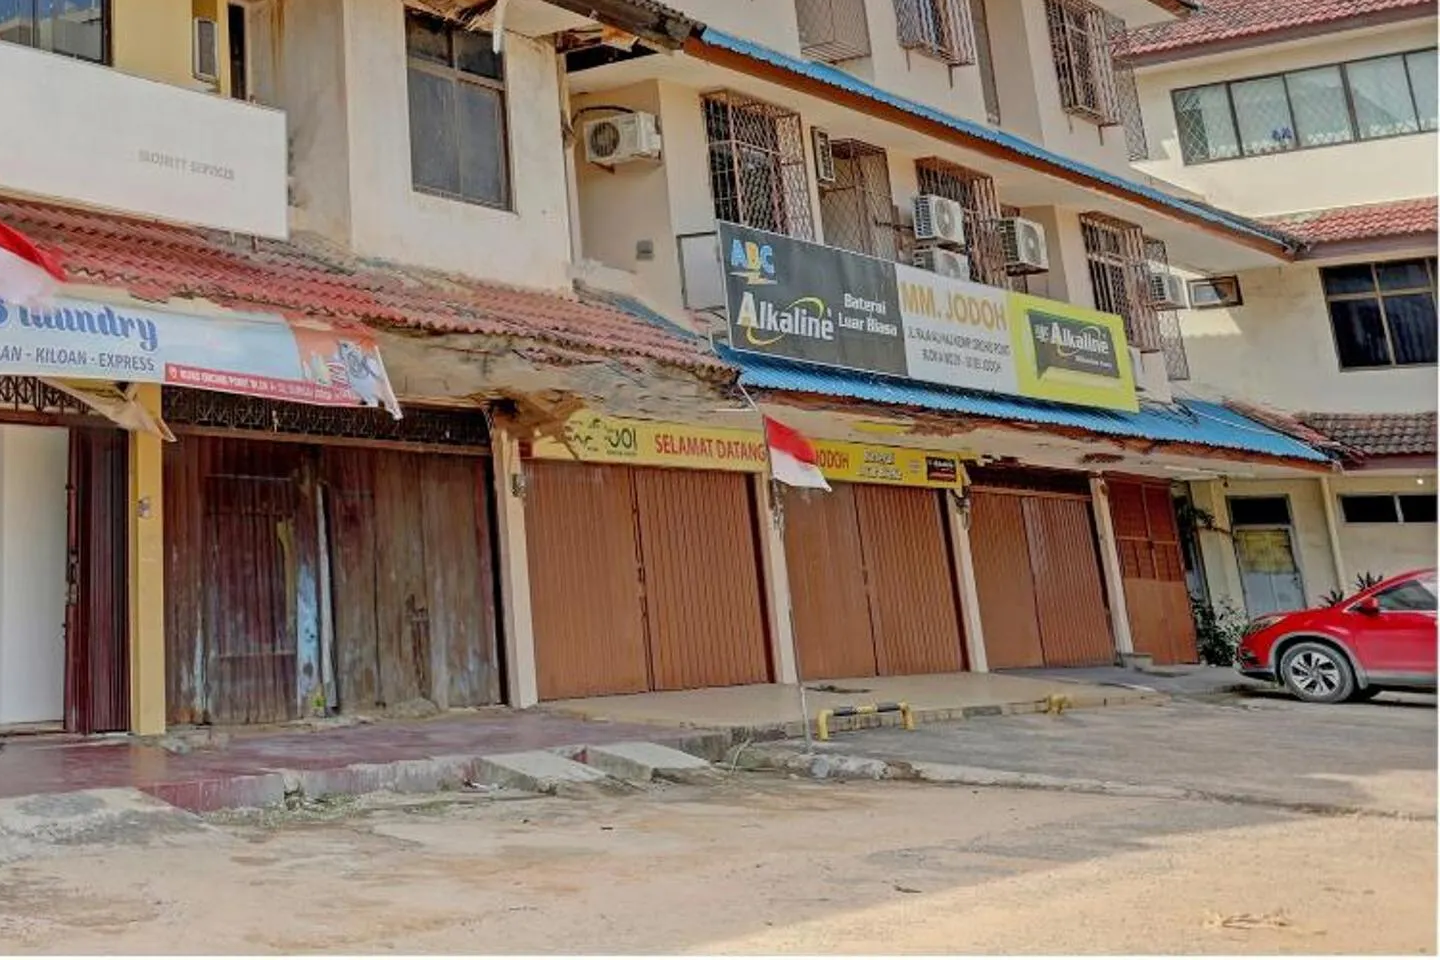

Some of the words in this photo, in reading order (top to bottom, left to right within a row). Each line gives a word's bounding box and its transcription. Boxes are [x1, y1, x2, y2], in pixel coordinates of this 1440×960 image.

[736, 291, 835, 340] Alkaline
[838, 312, 865, 330] Luar
[945, 290, 1007, 331] JODOH
[1050, 322, 1109, 353] Alkaline
[35, 347, 87, 365] KILOAN
[99, 353, 155, 372] EXPRESS
[654, 434, 713, 457] SELAMAT
[717, 440, 767, 462] DATANG
